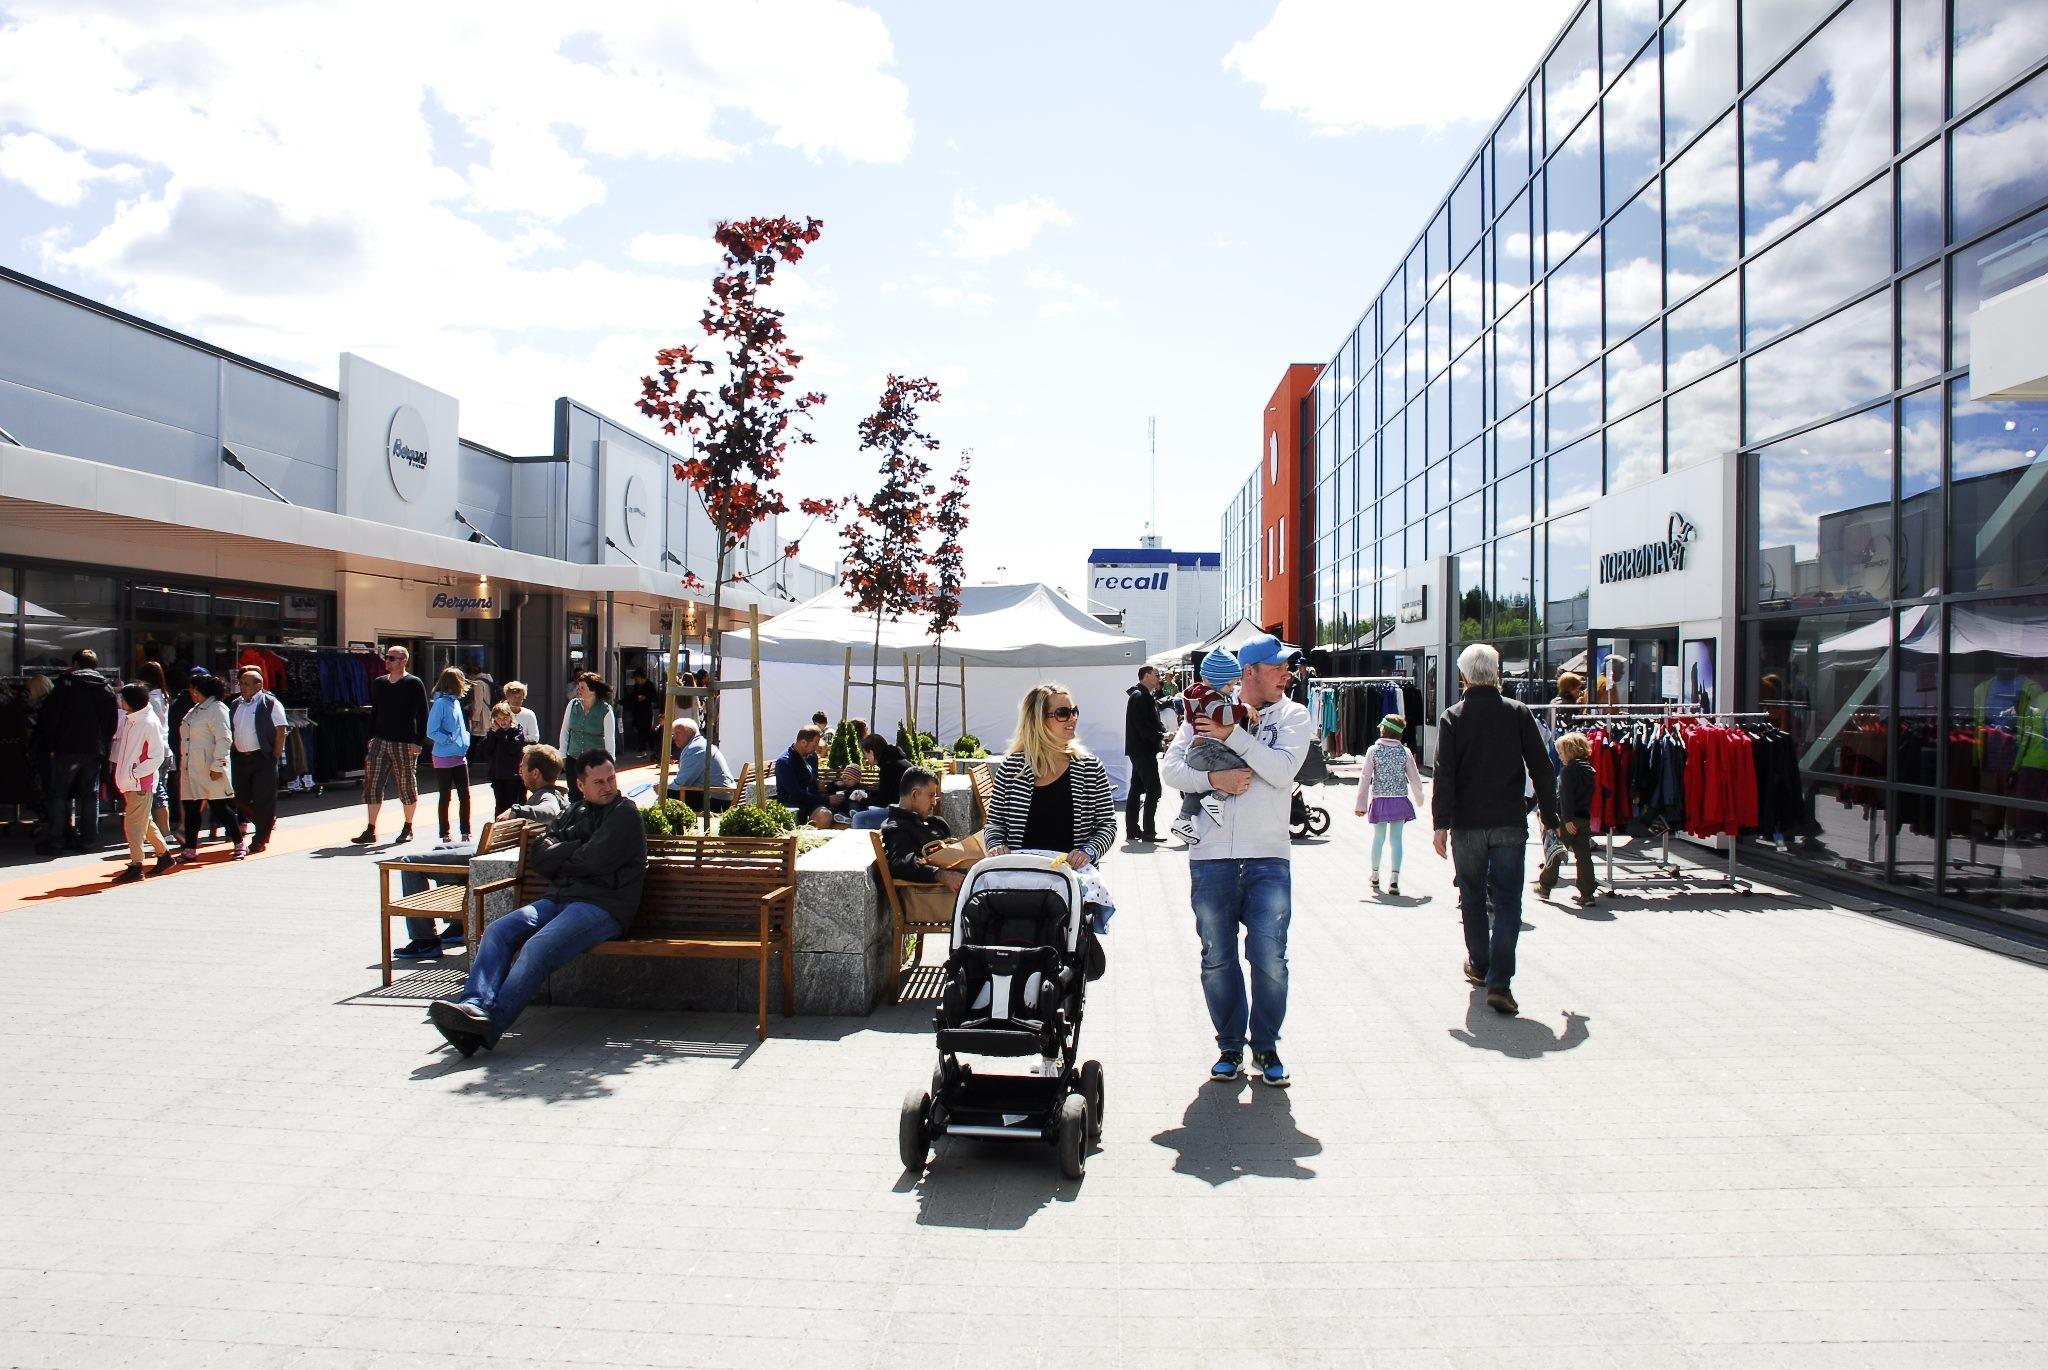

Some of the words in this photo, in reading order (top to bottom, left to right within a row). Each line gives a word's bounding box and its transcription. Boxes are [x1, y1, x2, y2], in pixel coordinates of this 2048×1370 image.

[393, 439, 427, 466] Bergans
[1600, 541, 1669, 584] NORRØNA
[1095, 572, 1168, 590] recall
[432, 593, 493, 611] Bergans
